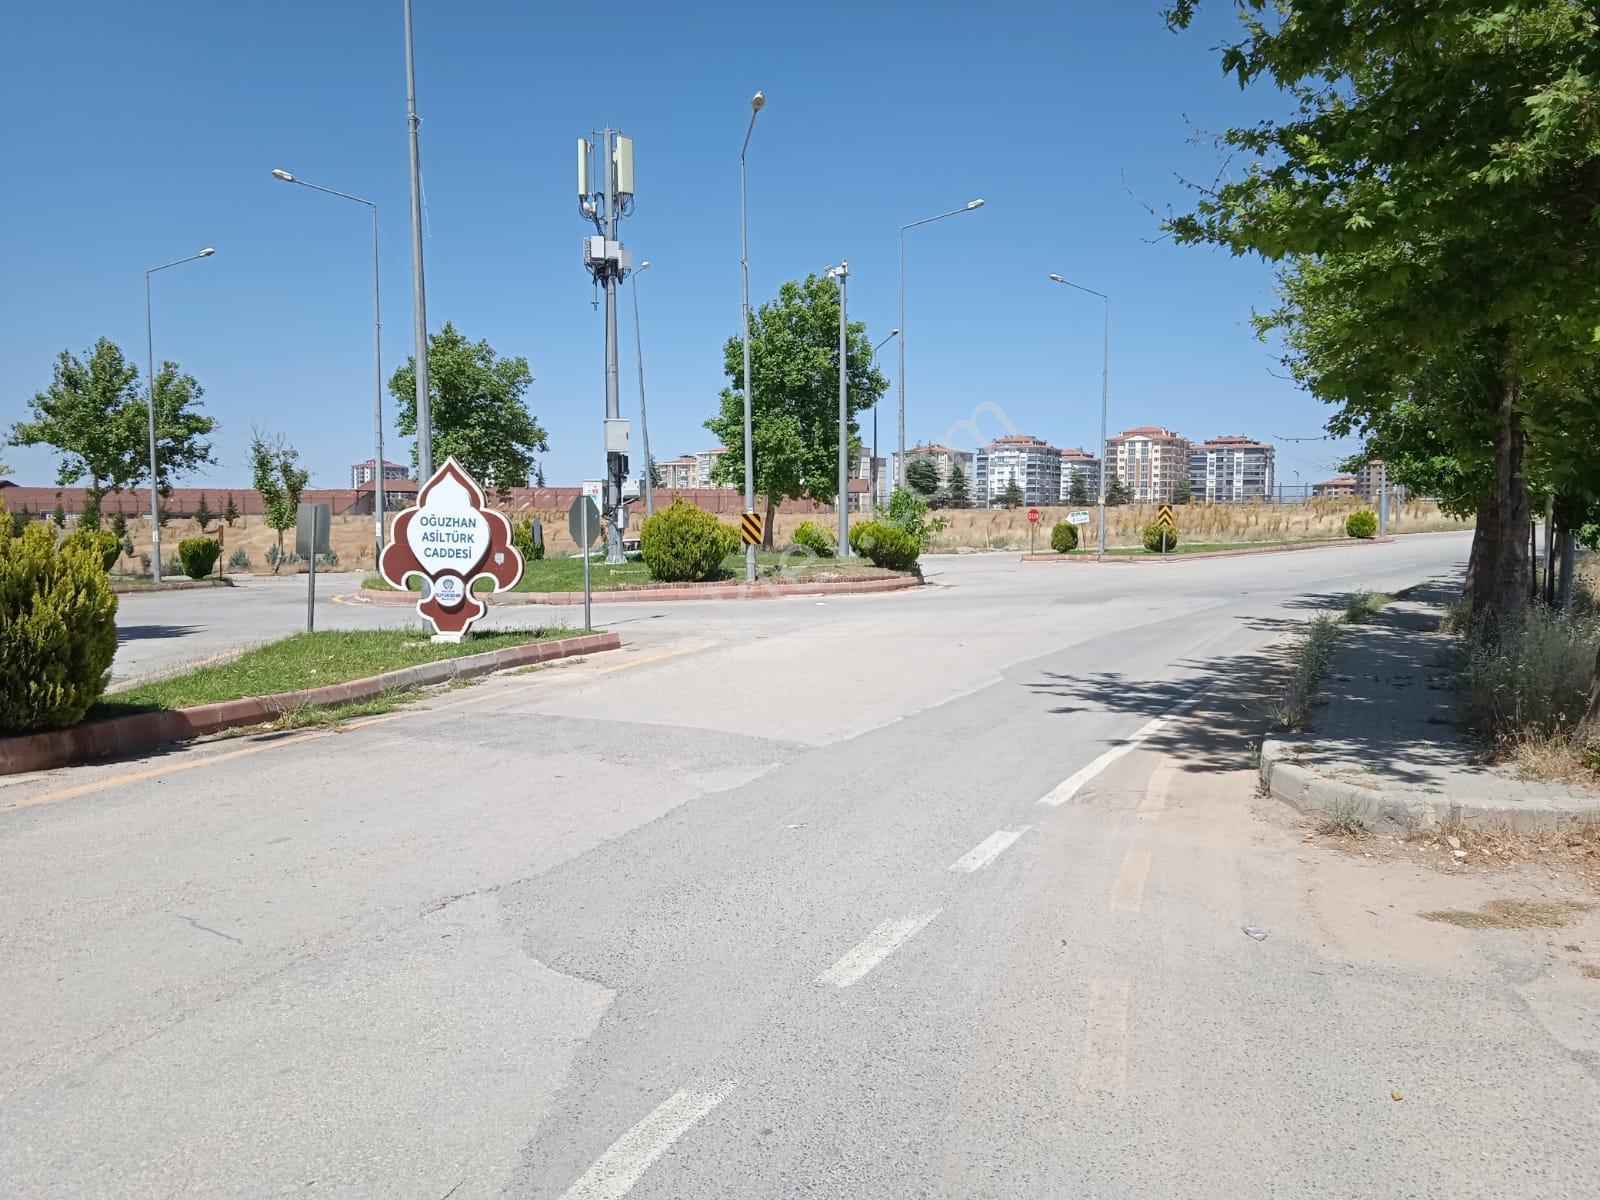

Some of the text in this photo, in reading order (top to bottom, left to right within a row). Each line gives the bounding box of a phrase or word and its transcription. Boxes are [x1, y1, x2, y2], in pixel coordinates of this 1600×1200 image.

[420, 513, 476, 528] OĞUZHAN
[421, 529, 475, 543] ASİLTÜRK
[424, 546, 472, 559] CADDESİ
